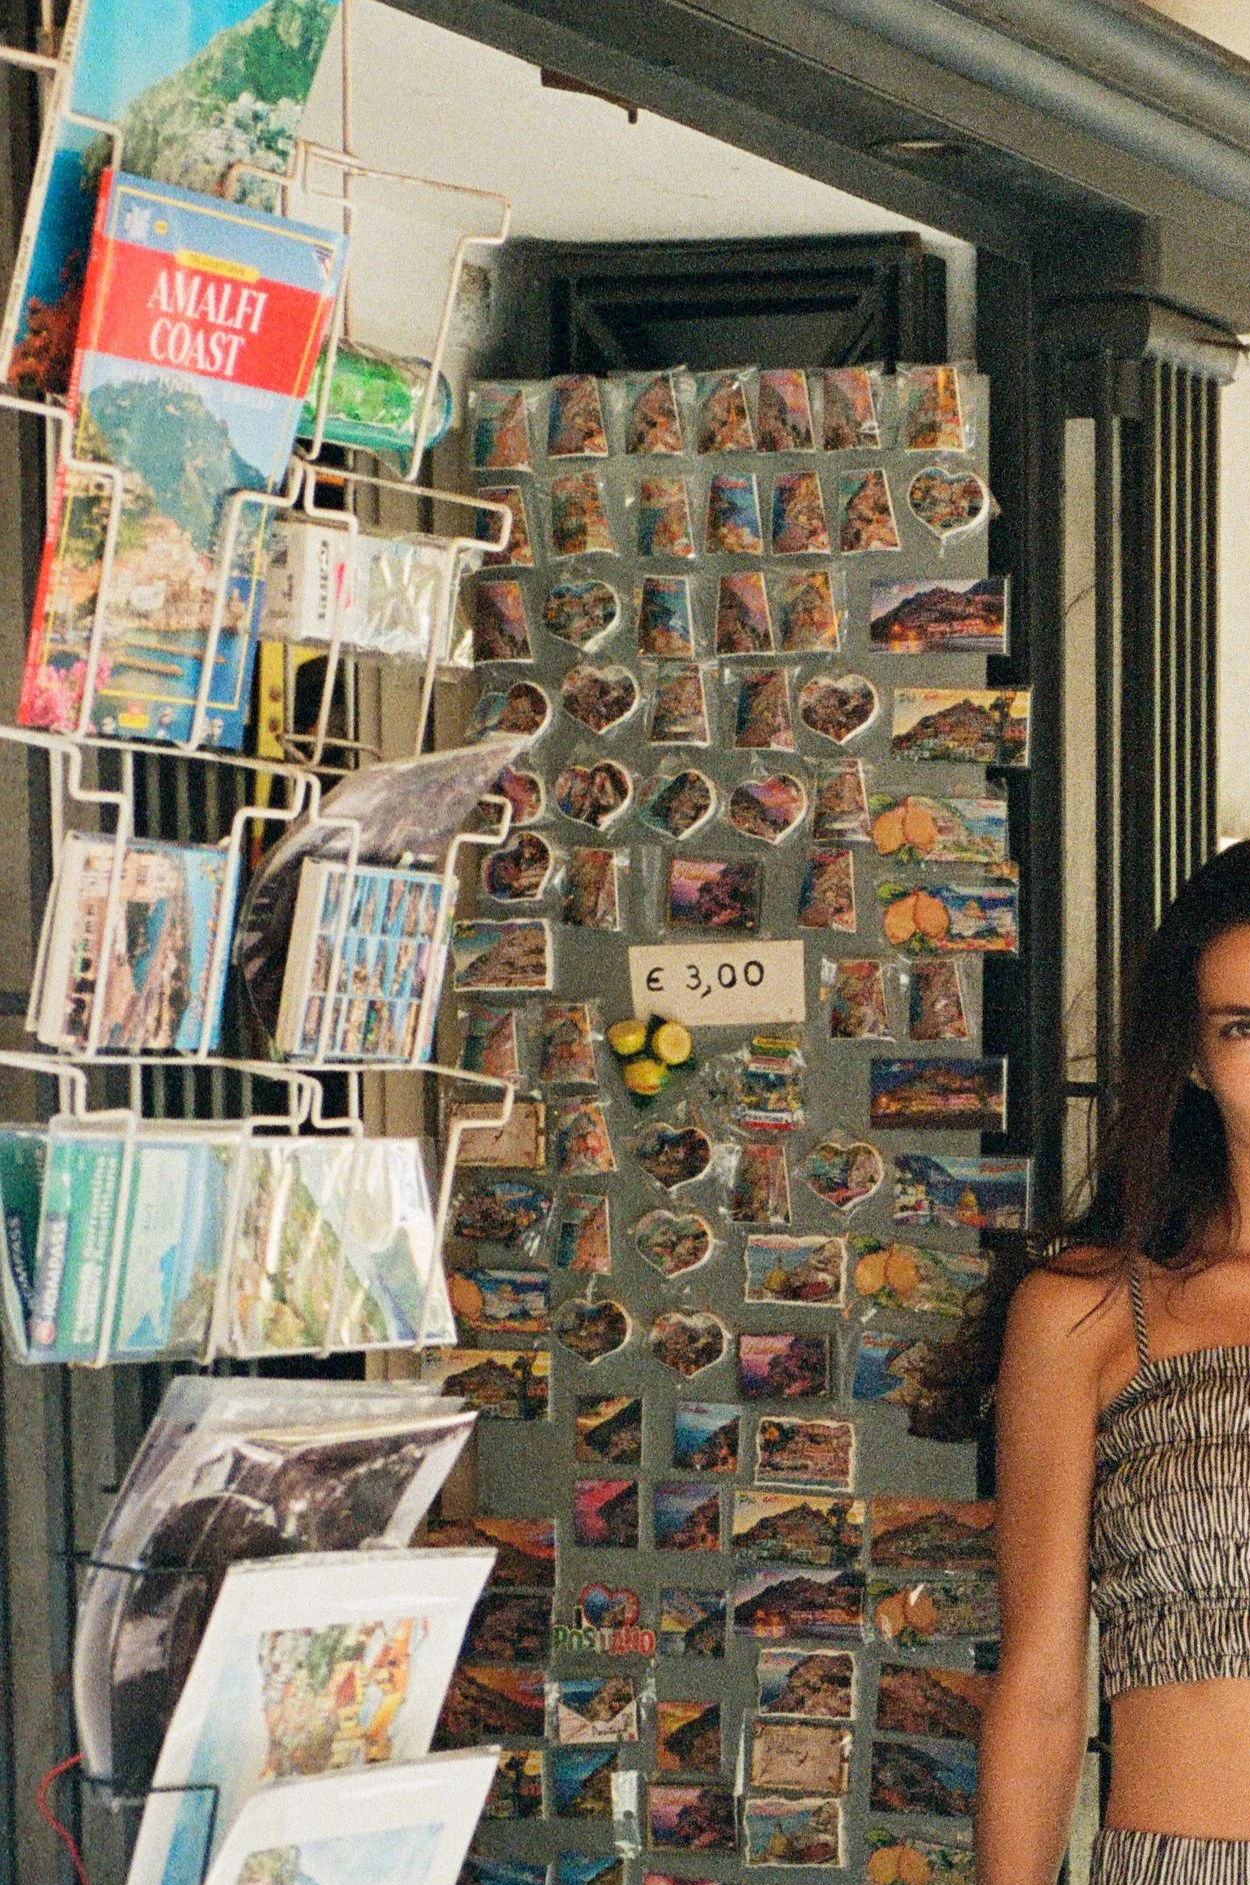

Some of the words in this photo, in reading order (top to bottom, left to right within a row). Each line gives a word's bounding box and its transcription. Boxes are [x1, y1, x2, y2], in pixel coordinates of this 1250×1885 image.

[147, 270, 269, 334] AMALFI
[149, 317, 245, 377] COAST
[646, 967, 664, 992] €
[686, 960, 765, 999] 3,00
[43, 1219, 68, 1317] KOMPASS
